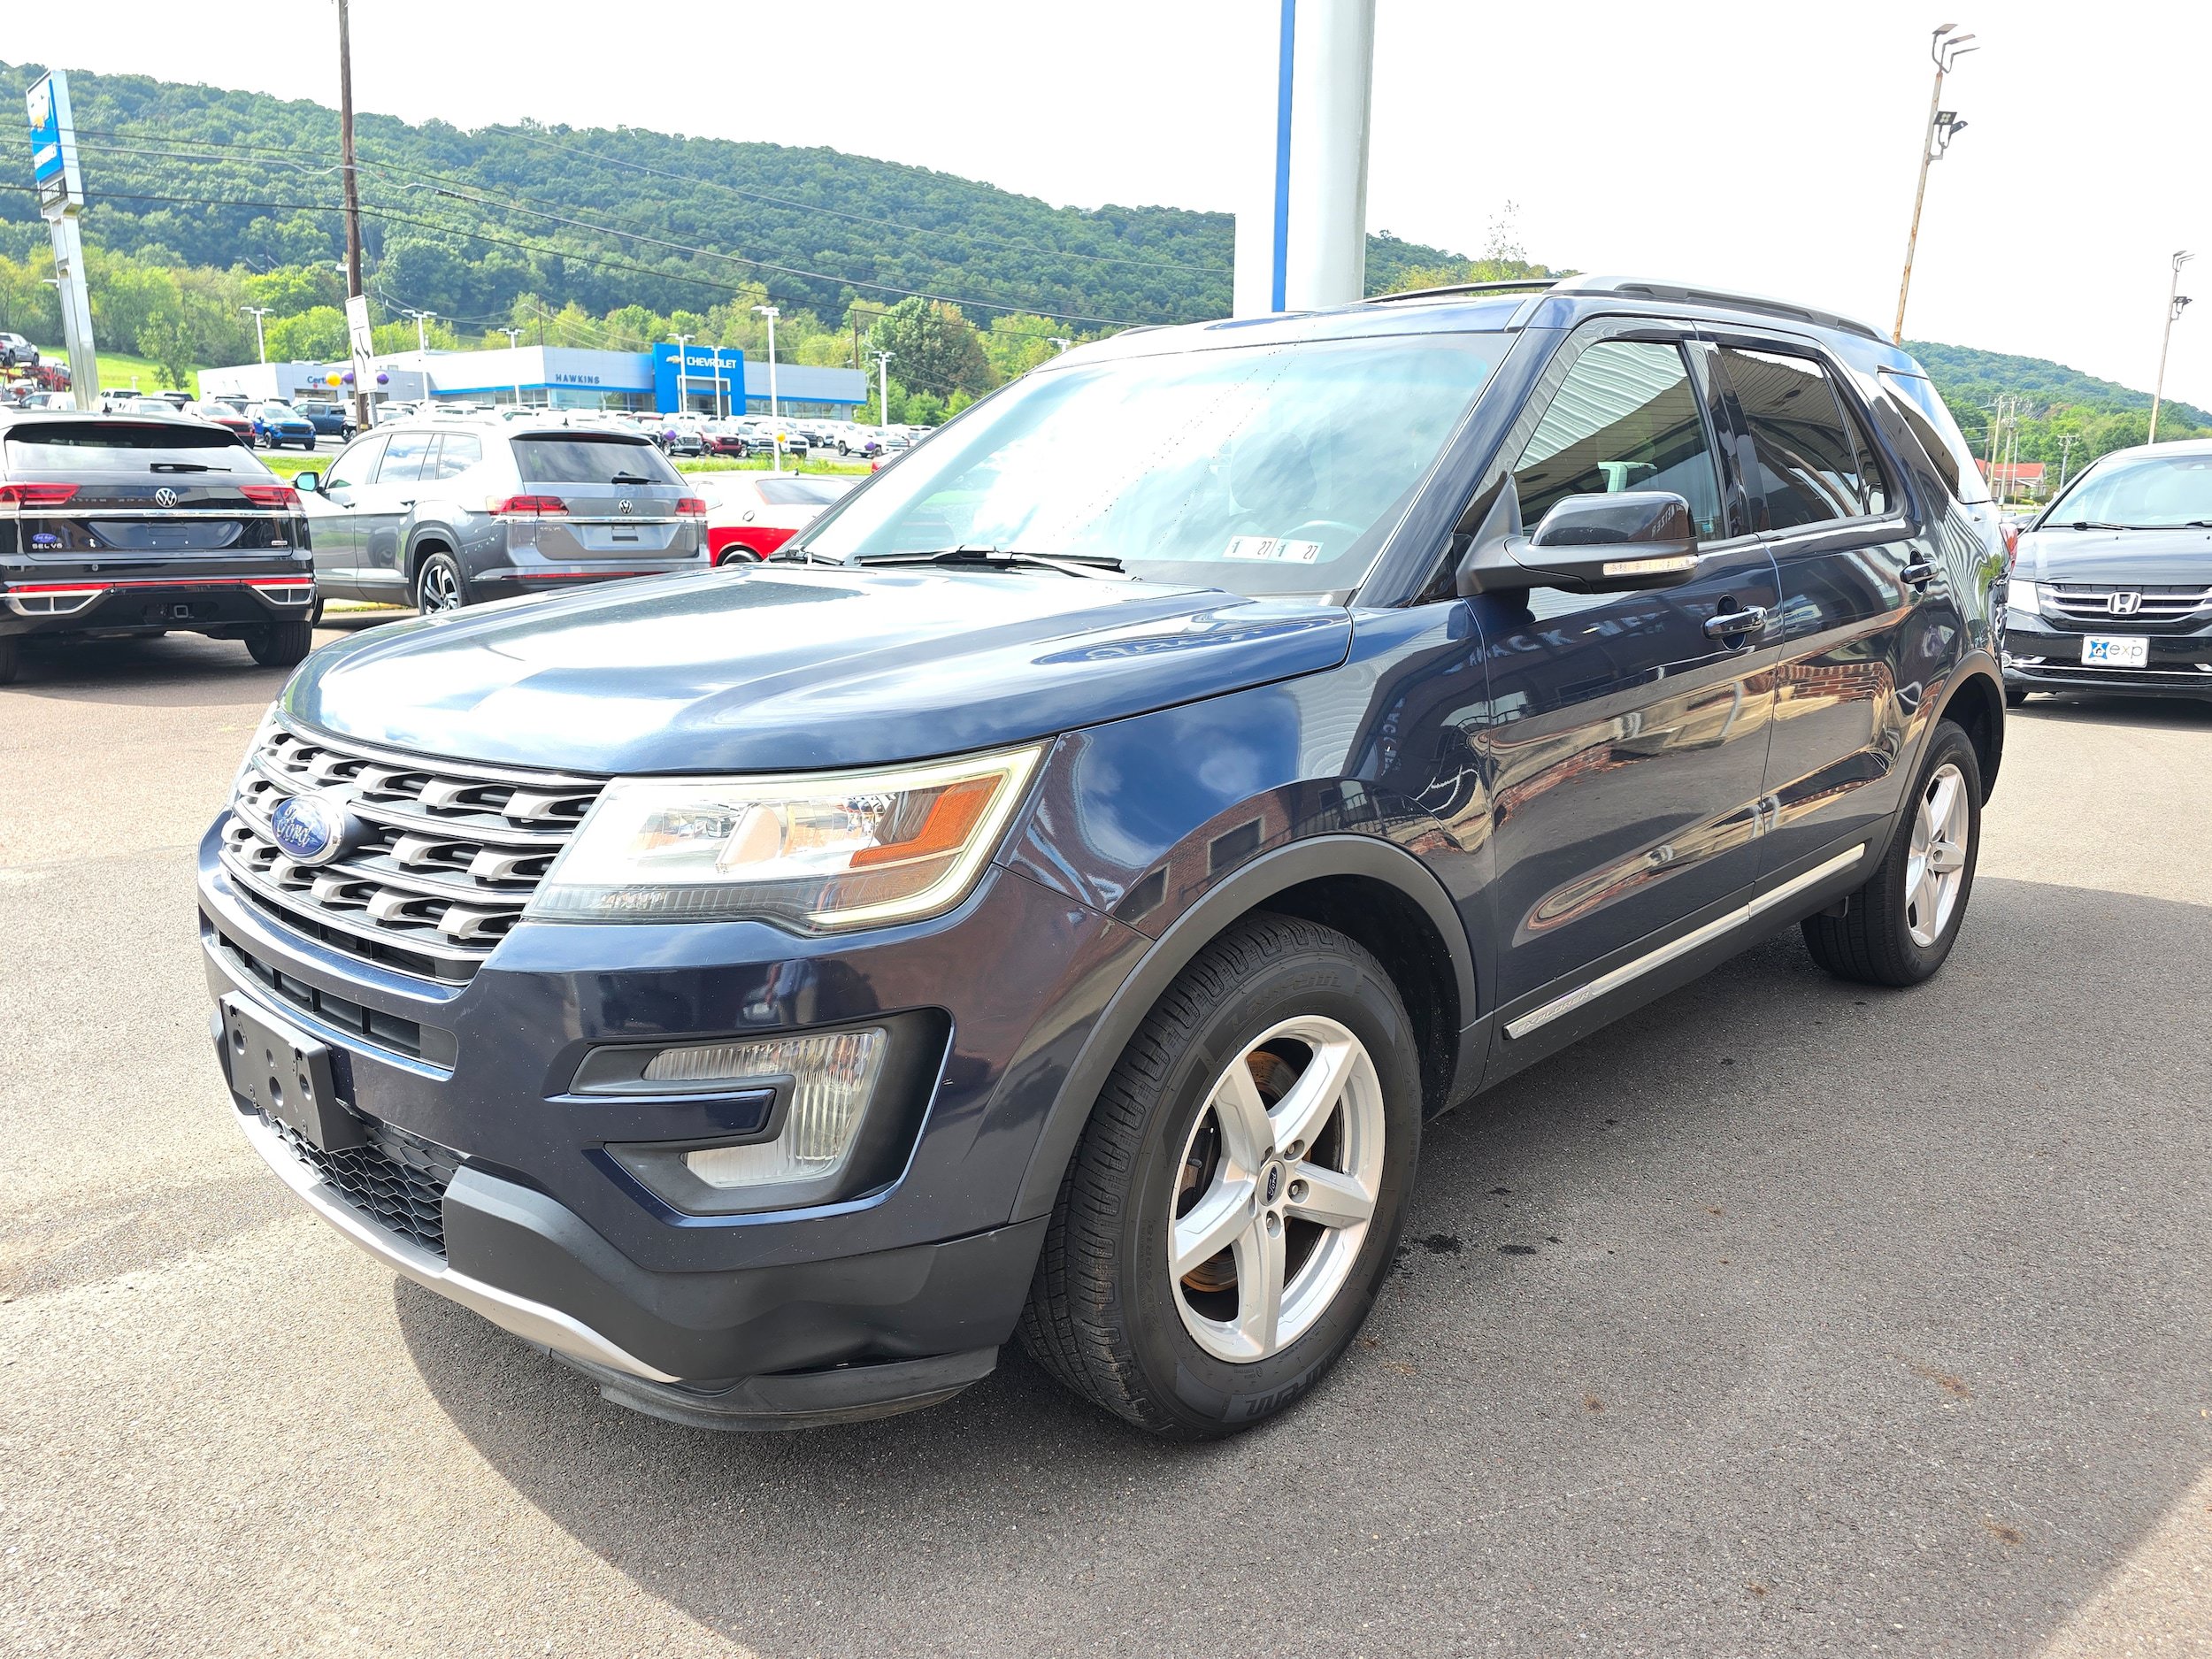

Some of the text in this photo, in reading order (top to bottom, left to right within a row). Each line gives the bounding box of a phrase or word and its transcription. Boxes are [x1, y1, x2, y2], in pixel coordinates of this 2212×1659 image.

[686, 356, 737, 369] CHEVROLET
[555, 373, 600, 384] HAWKINS
[1256, 541, 1273, 556] 27
[1302, 545, 1319, 560] 27
[2109, 644, 2143, 659] exp
[277, 804, 316, 848] Ford
[1516, 990, 1591, 1034] EXPLORER
[1267, 1171, 1277, 1196] Ford
